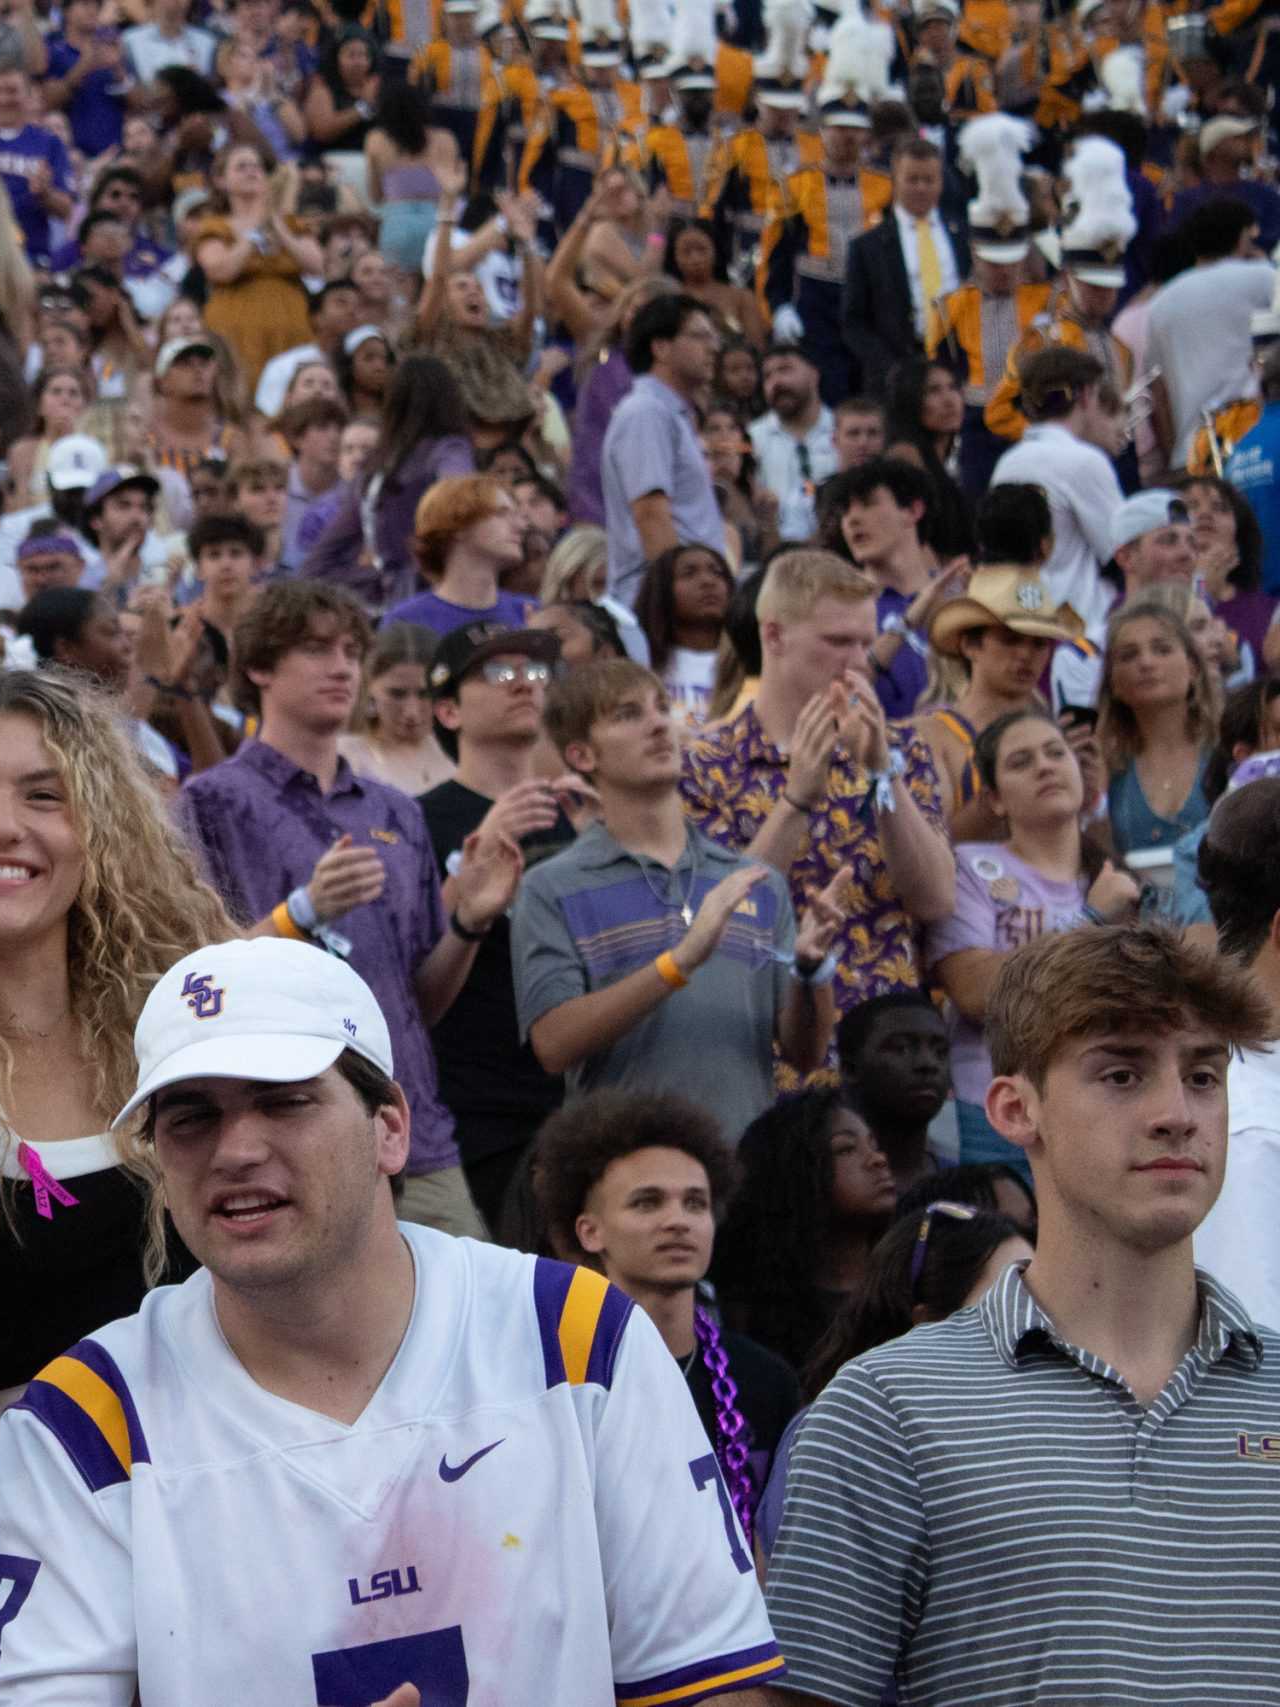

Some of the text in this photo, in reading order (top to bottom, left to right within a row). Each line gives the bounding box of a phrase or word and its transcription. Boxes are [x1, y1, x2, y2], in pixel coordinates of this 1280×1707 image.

[181, 972, 224, 1018] LSU
[1237, 1432, 1280, 1460] LS
[688, 1452, 754, 1574] 7
[348, 1566, 422, 1606] LSU
